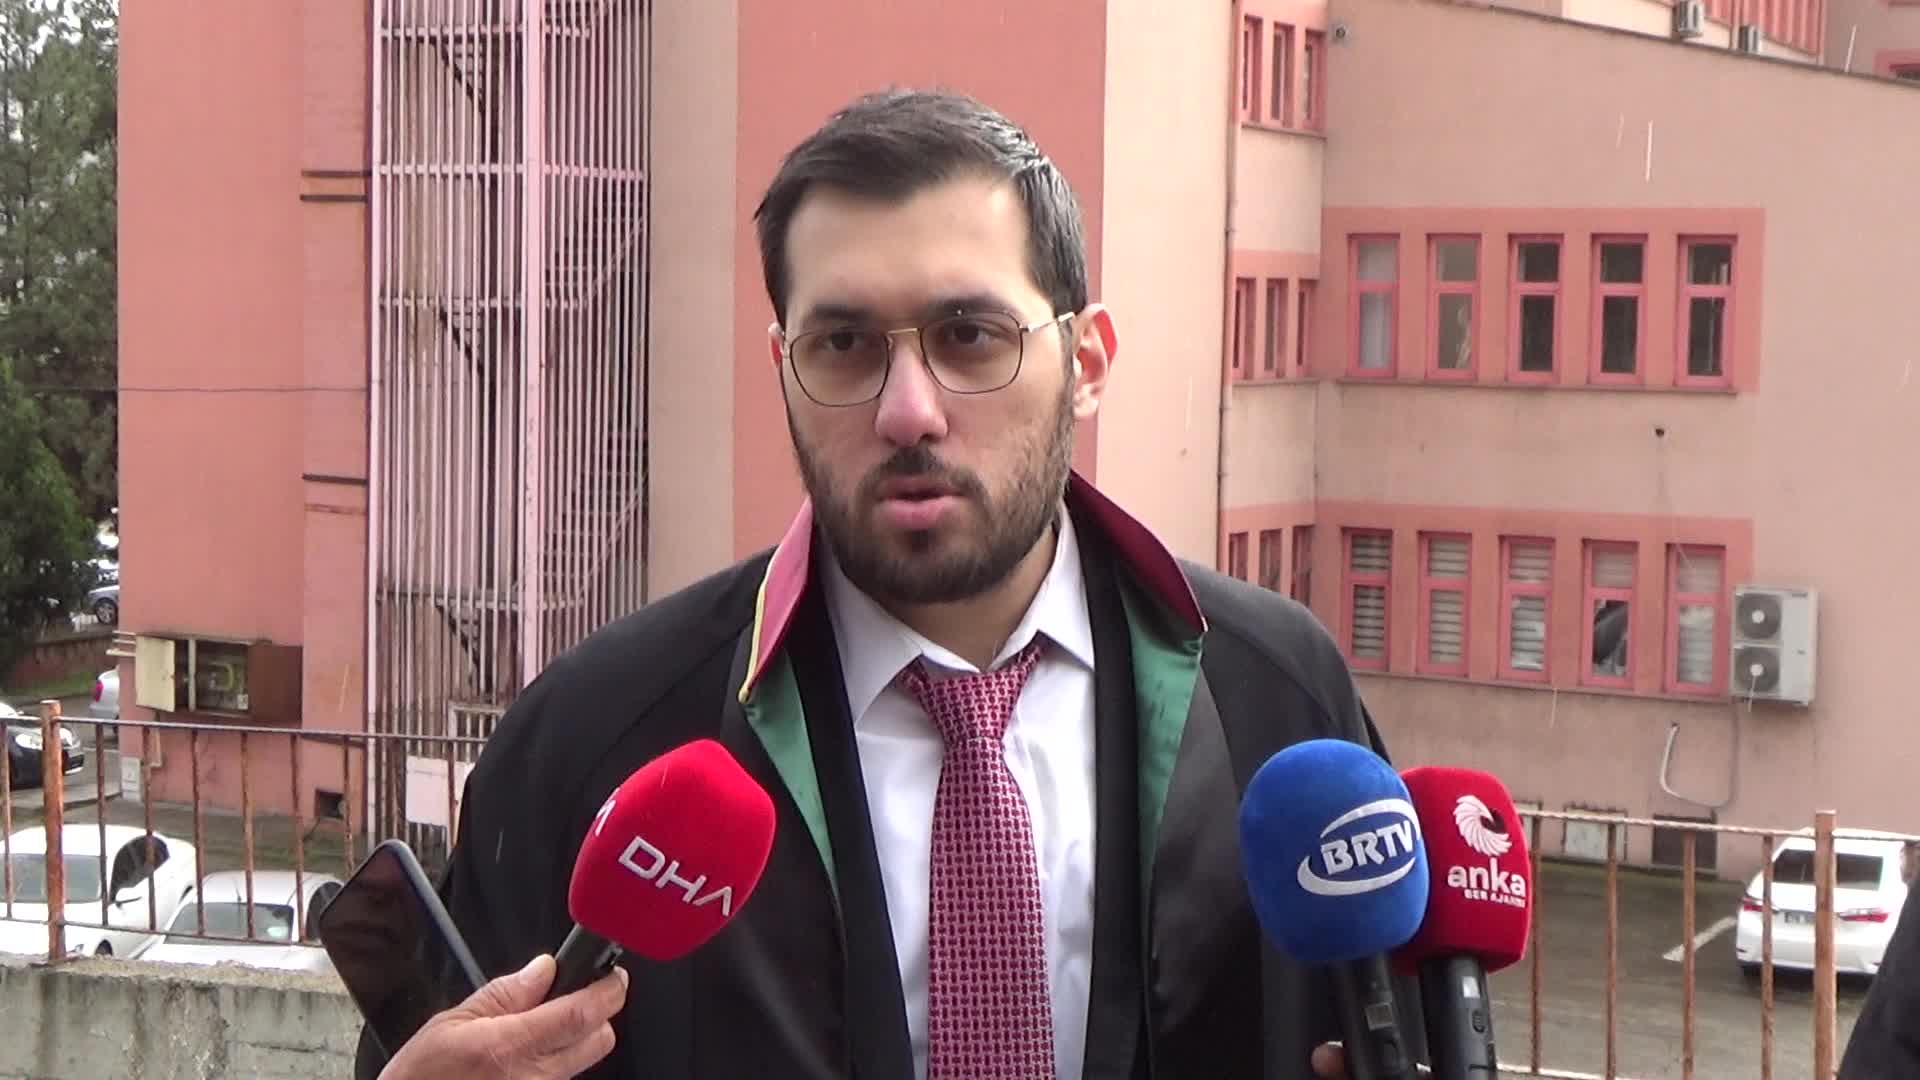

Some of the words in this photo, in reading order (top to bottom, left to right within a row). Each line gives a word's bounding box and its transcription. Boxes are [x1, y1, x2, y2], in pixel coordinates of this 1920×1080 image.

[1321, 820, 1413, 875] BRTV
[618, 836, 732, 917] DHA
[1447, 857, 1526, 898] anka
